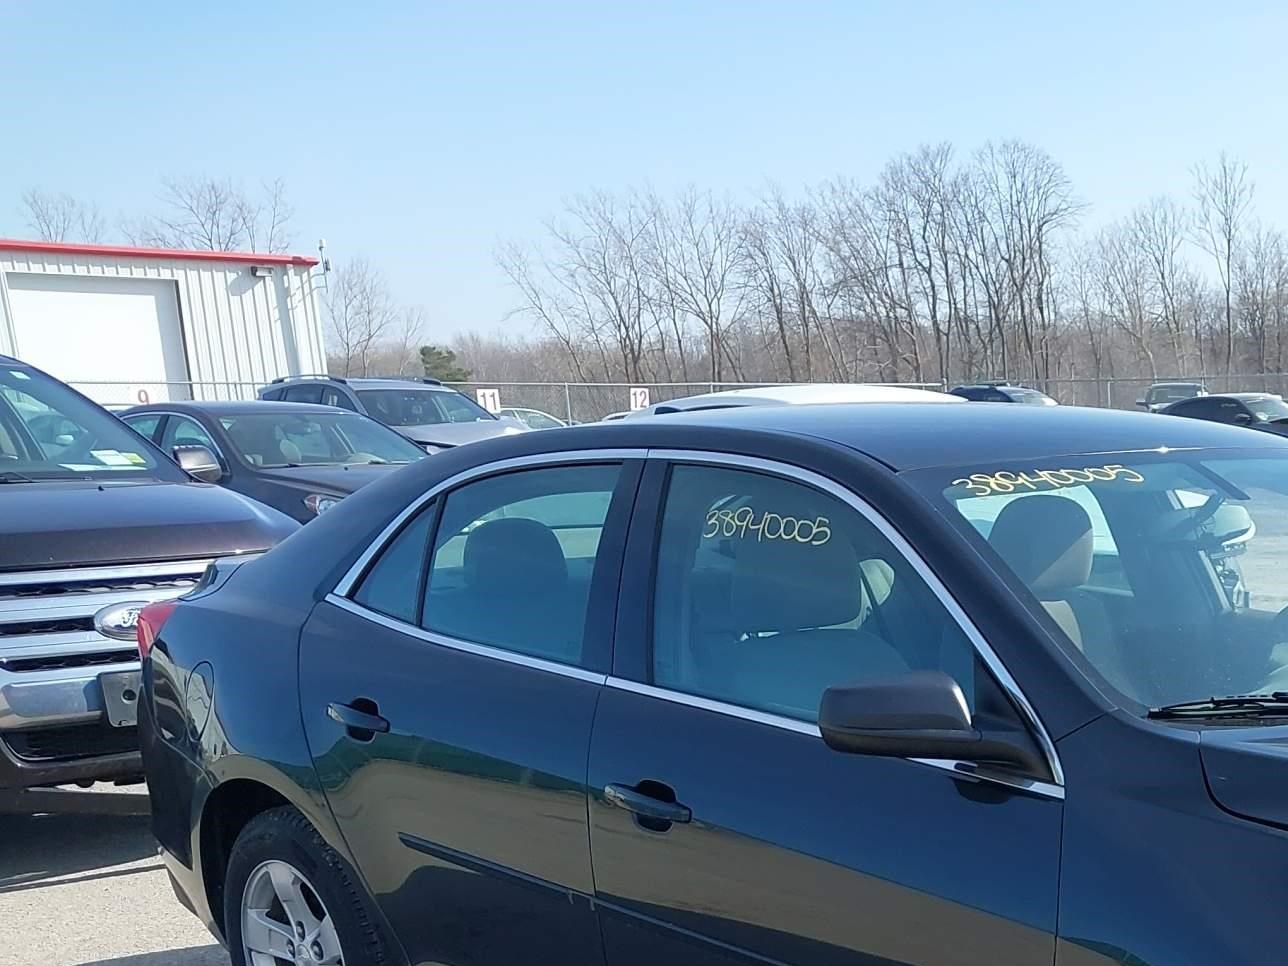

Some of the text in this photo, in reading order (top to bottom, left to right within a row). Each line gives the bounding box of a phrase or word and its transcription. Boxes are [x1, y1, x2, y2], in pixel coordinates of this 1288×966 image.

[480, 391, 497, 410] 11
[631, 390, 647, 408] 12
[952, 465, 1145, 497] 38940005
[703, 507, 831, 545] 38940005
